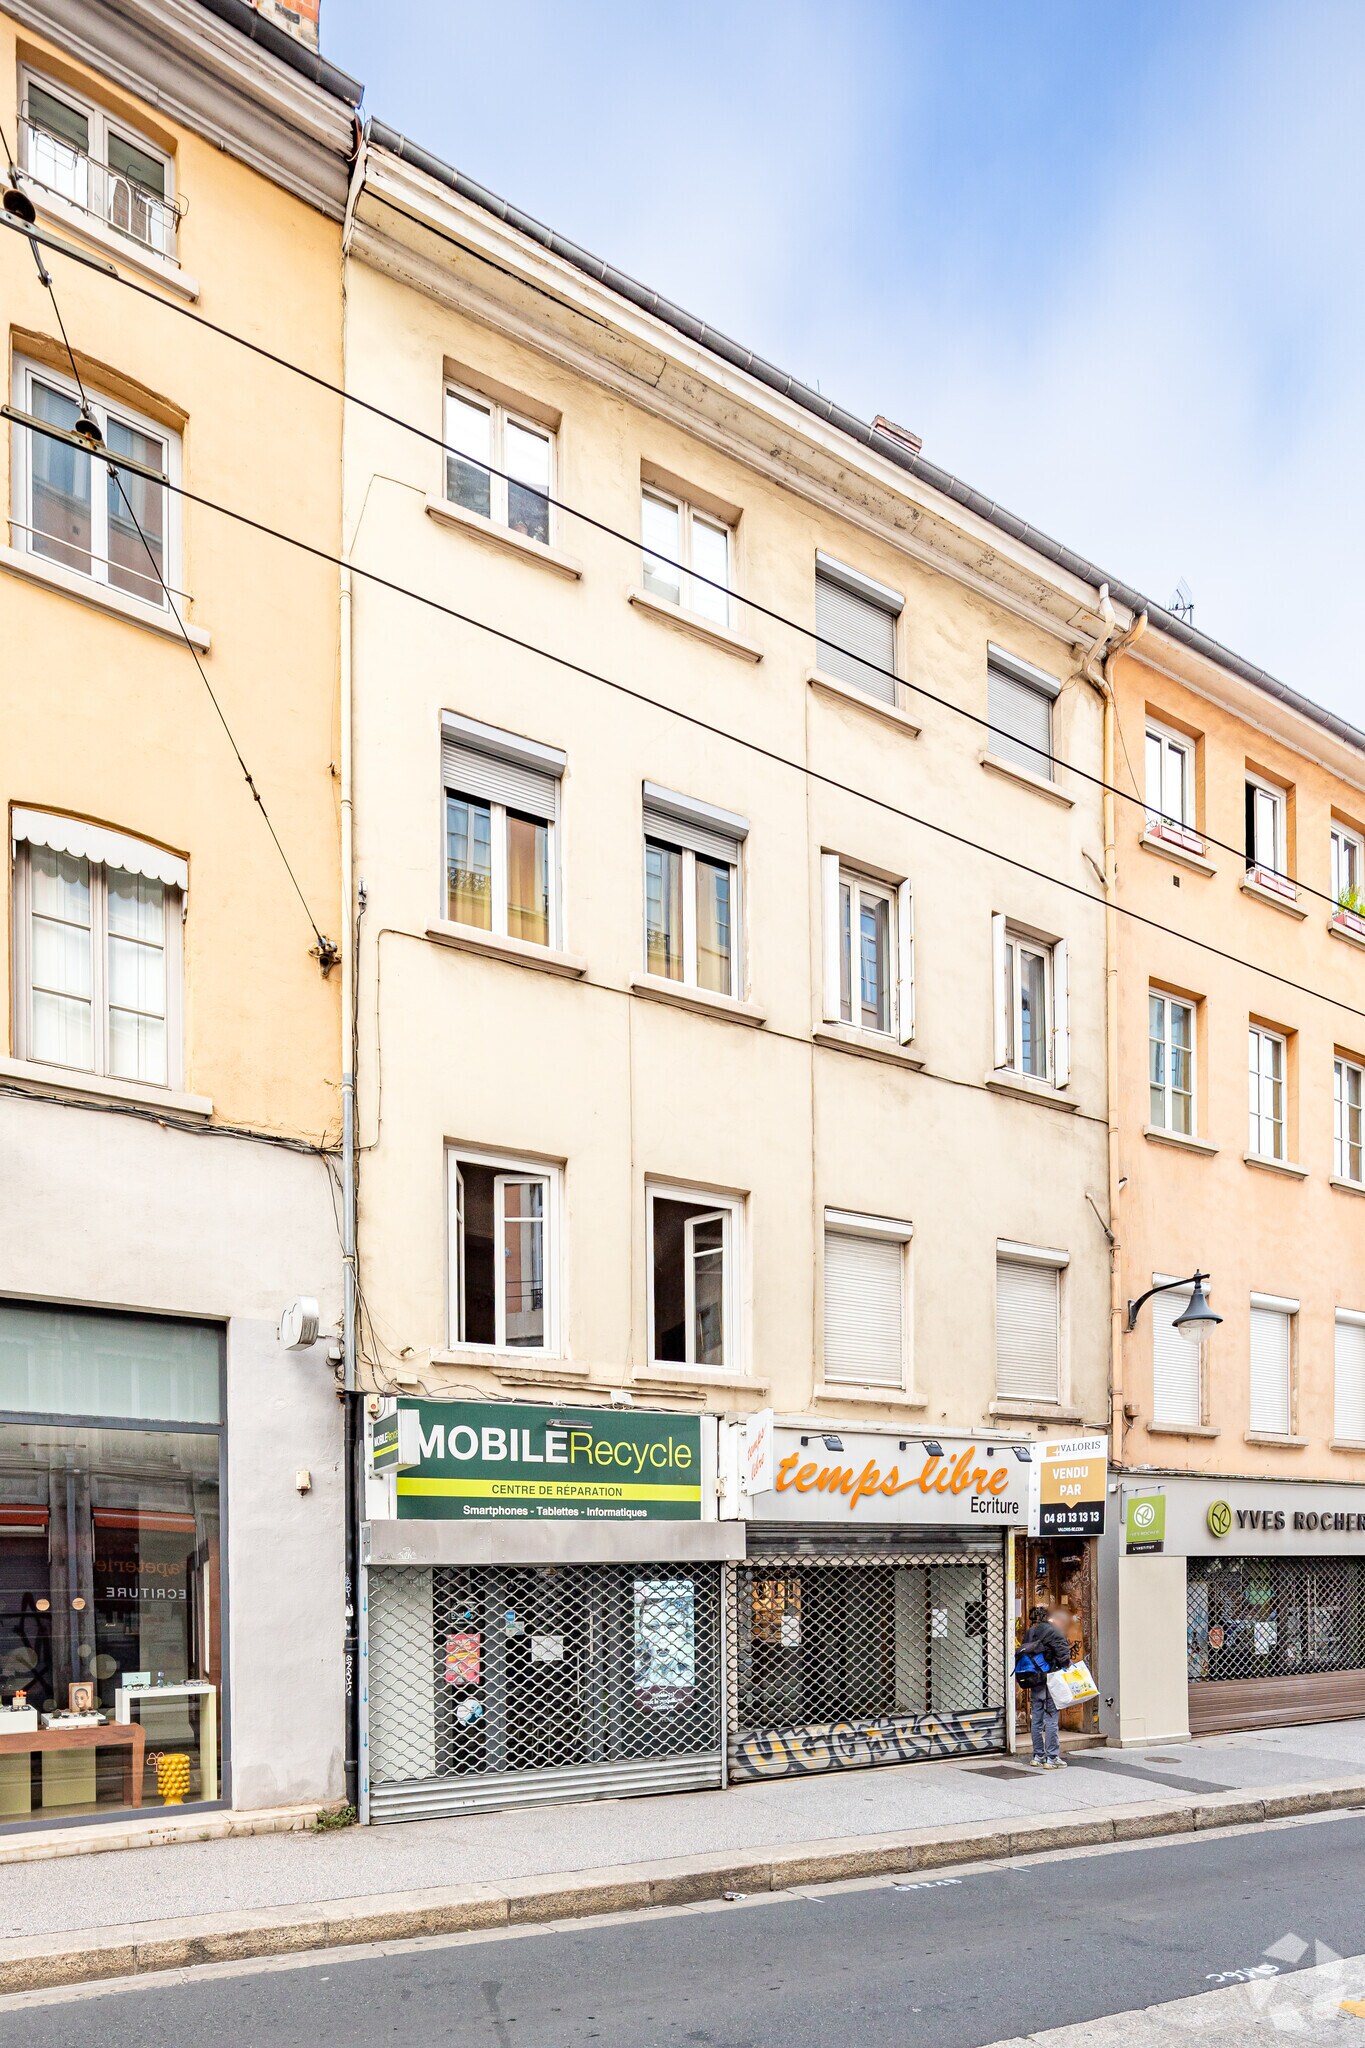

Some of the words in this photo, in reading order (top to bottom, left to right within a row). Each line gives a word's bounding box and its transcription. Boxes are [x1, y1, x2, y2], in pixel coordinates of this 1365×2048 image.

[1060, 1441, 1101, 1452] VALORIS
[776, 1452, 905, 1510] temps
[919, 1446, 1009, 1495] libre
[1052, 1465, 1089, 1480] VENDU
[491, 1484, 536, 1495] CENTRE
[538, 1485, 553, 1495] DE
[556, 1484, 623, 1497] RÉPARATION
[1059, 1483, 1082, 1496] PAR
[463, 1504, 528, 1517] Smartphones
[536, 1506, 579, 1516] Tablettes
[586, 1507, 648, 1519] Informatiques
[970, 1496, 1019, 1514] Ecriture
[1044, 1512, 1056, 1523] 04
[1056, 1512, 1066, 1523] 81
[1067, 1512, 1078, 1523] 13
[1079, 1511, 1089, 1522] 13
[1090, 1511, 1100, 1522] 13
[1235, 1509, 1287, 1530] YVES
[1293, 1511, 1365, 1532] ROCHER
